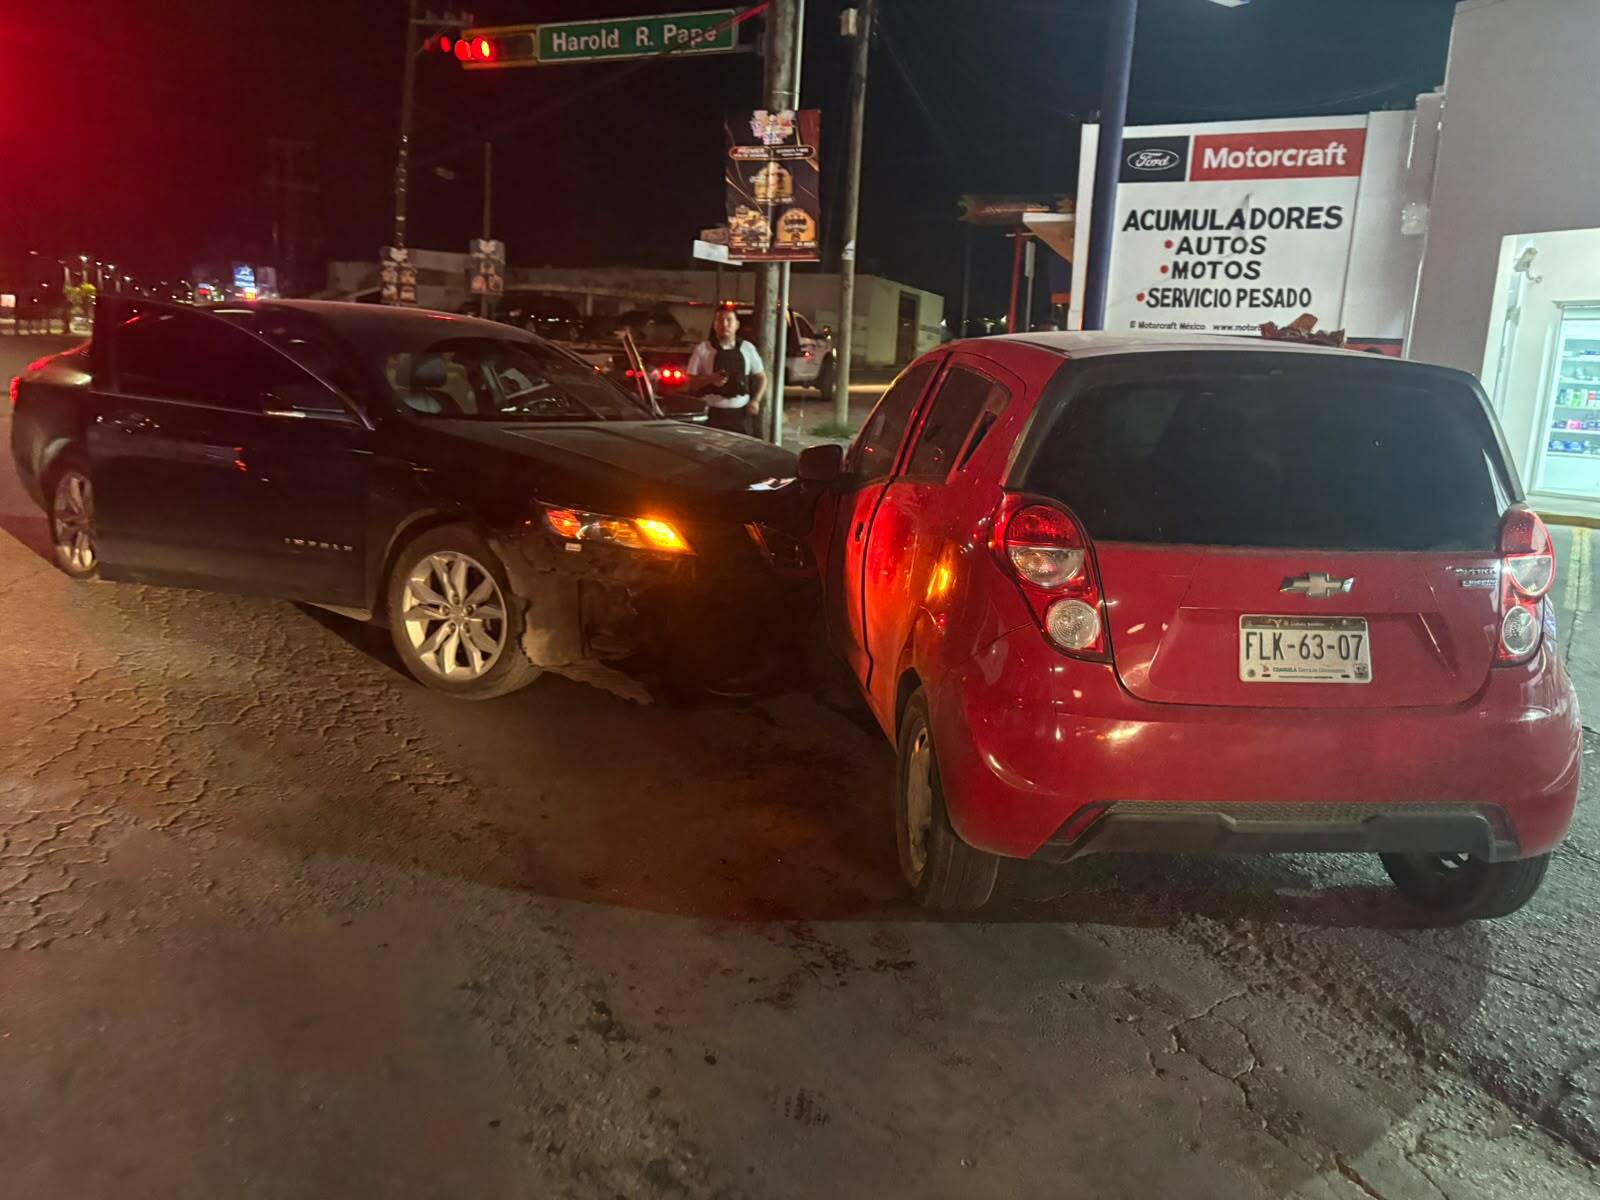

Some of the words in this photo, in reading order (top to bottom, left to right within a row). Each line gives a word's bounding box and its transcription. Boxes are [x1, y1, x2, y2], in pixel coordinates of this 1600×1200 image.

[552, 28, 620, 52] Harold
[635, 26, 654, 46] R.
[663, 24, 717, 47] Pape
[1135, 152, 1170, 167] Ford
[1202, 141, 1348, 169] Motorcraft
[1122, 206, 1343, 232] ACUMULADORES
[1175, 236, 1267, 255] AUTOS
[1171, 261, 1261, 280] MOTOS
[1145, 288, 1232, 309] SERVICIO
[1236, 287, 1312, 308] PESADO
[1138, 321, 1177, 330] Motorcraft
[1246, 631, 1363, 661] FLK-63-07
